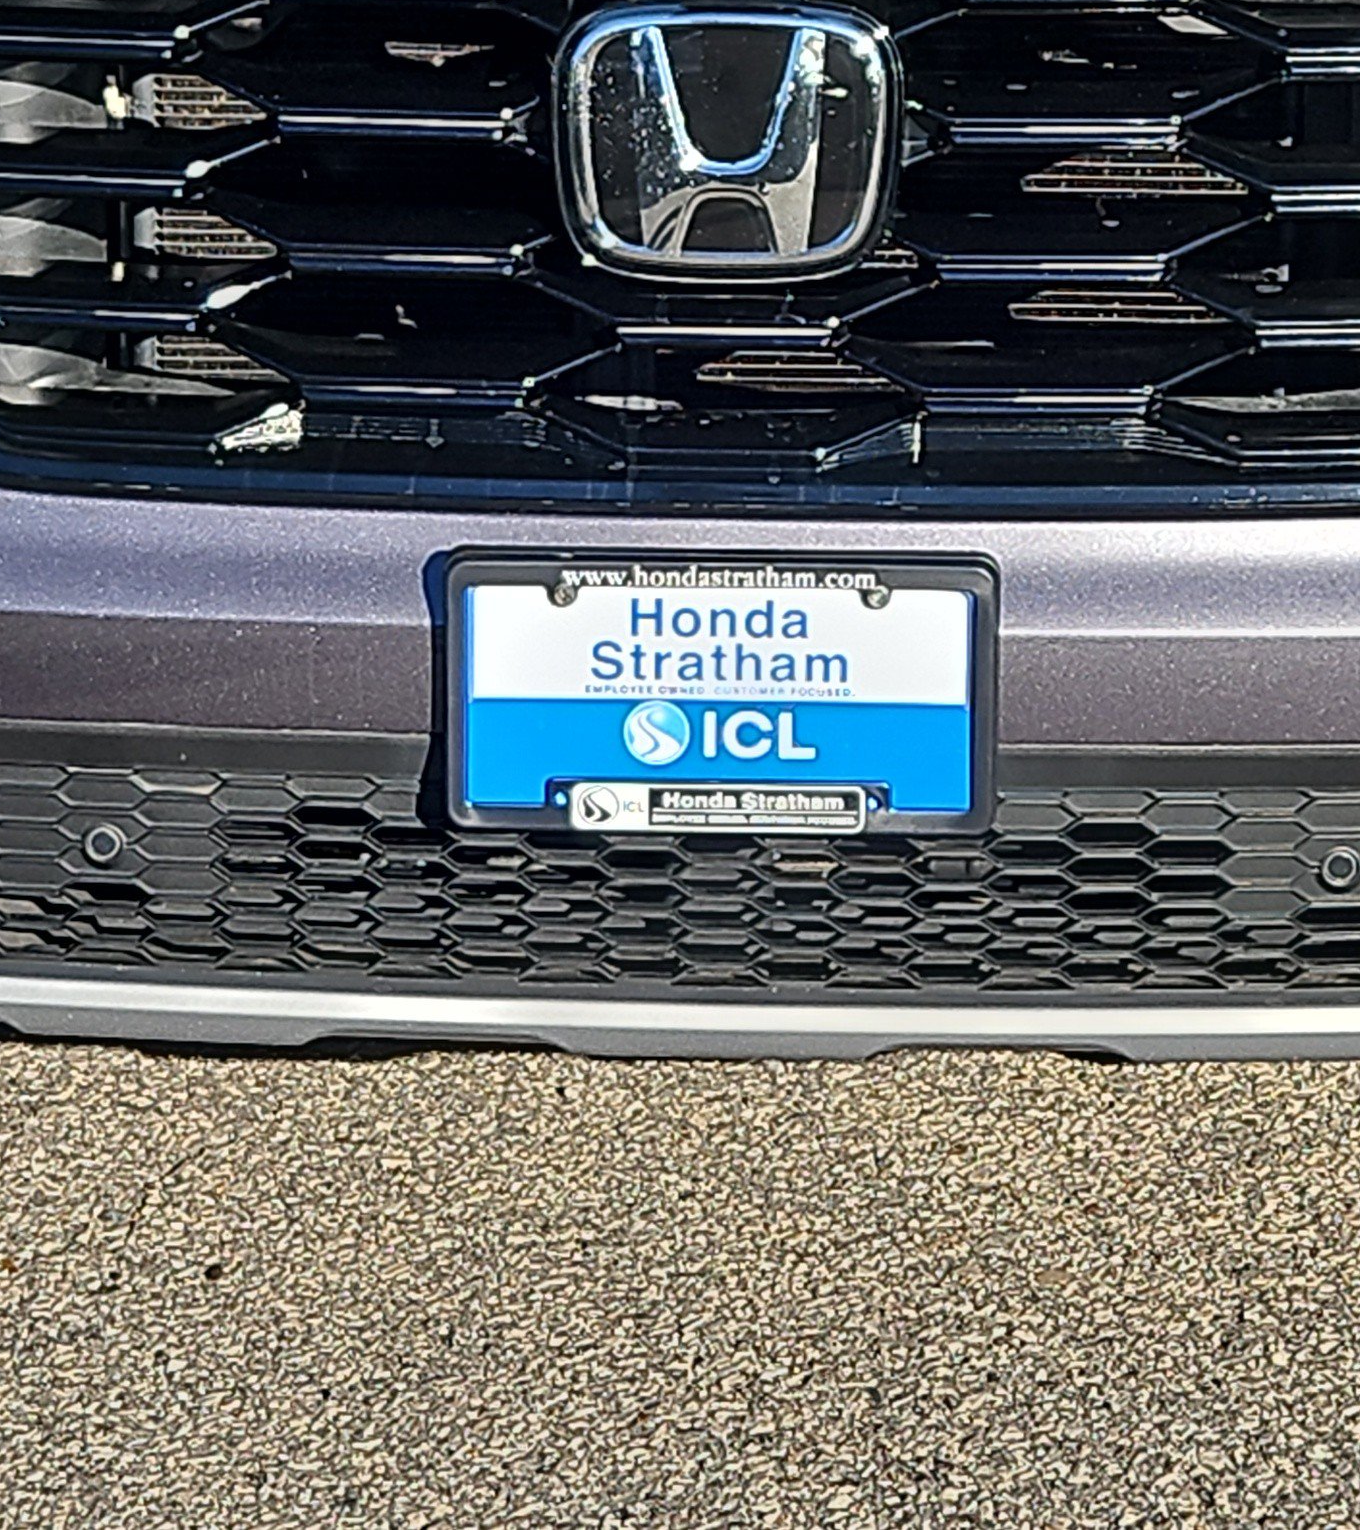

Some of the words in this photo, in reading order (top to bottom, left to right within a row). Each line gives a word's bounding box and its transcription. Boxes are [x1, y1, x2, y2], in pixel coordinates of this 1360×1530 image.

[561, 564, 877, 589] www.hondastratham.com
[630, 597, 808, 639] Honda
[590, 640, 849, 683] Stratham
[702, 709, 817, 761] ICL
[661, 790, 737, 810] Honda
[741, 791, 846, 812] Stratham
